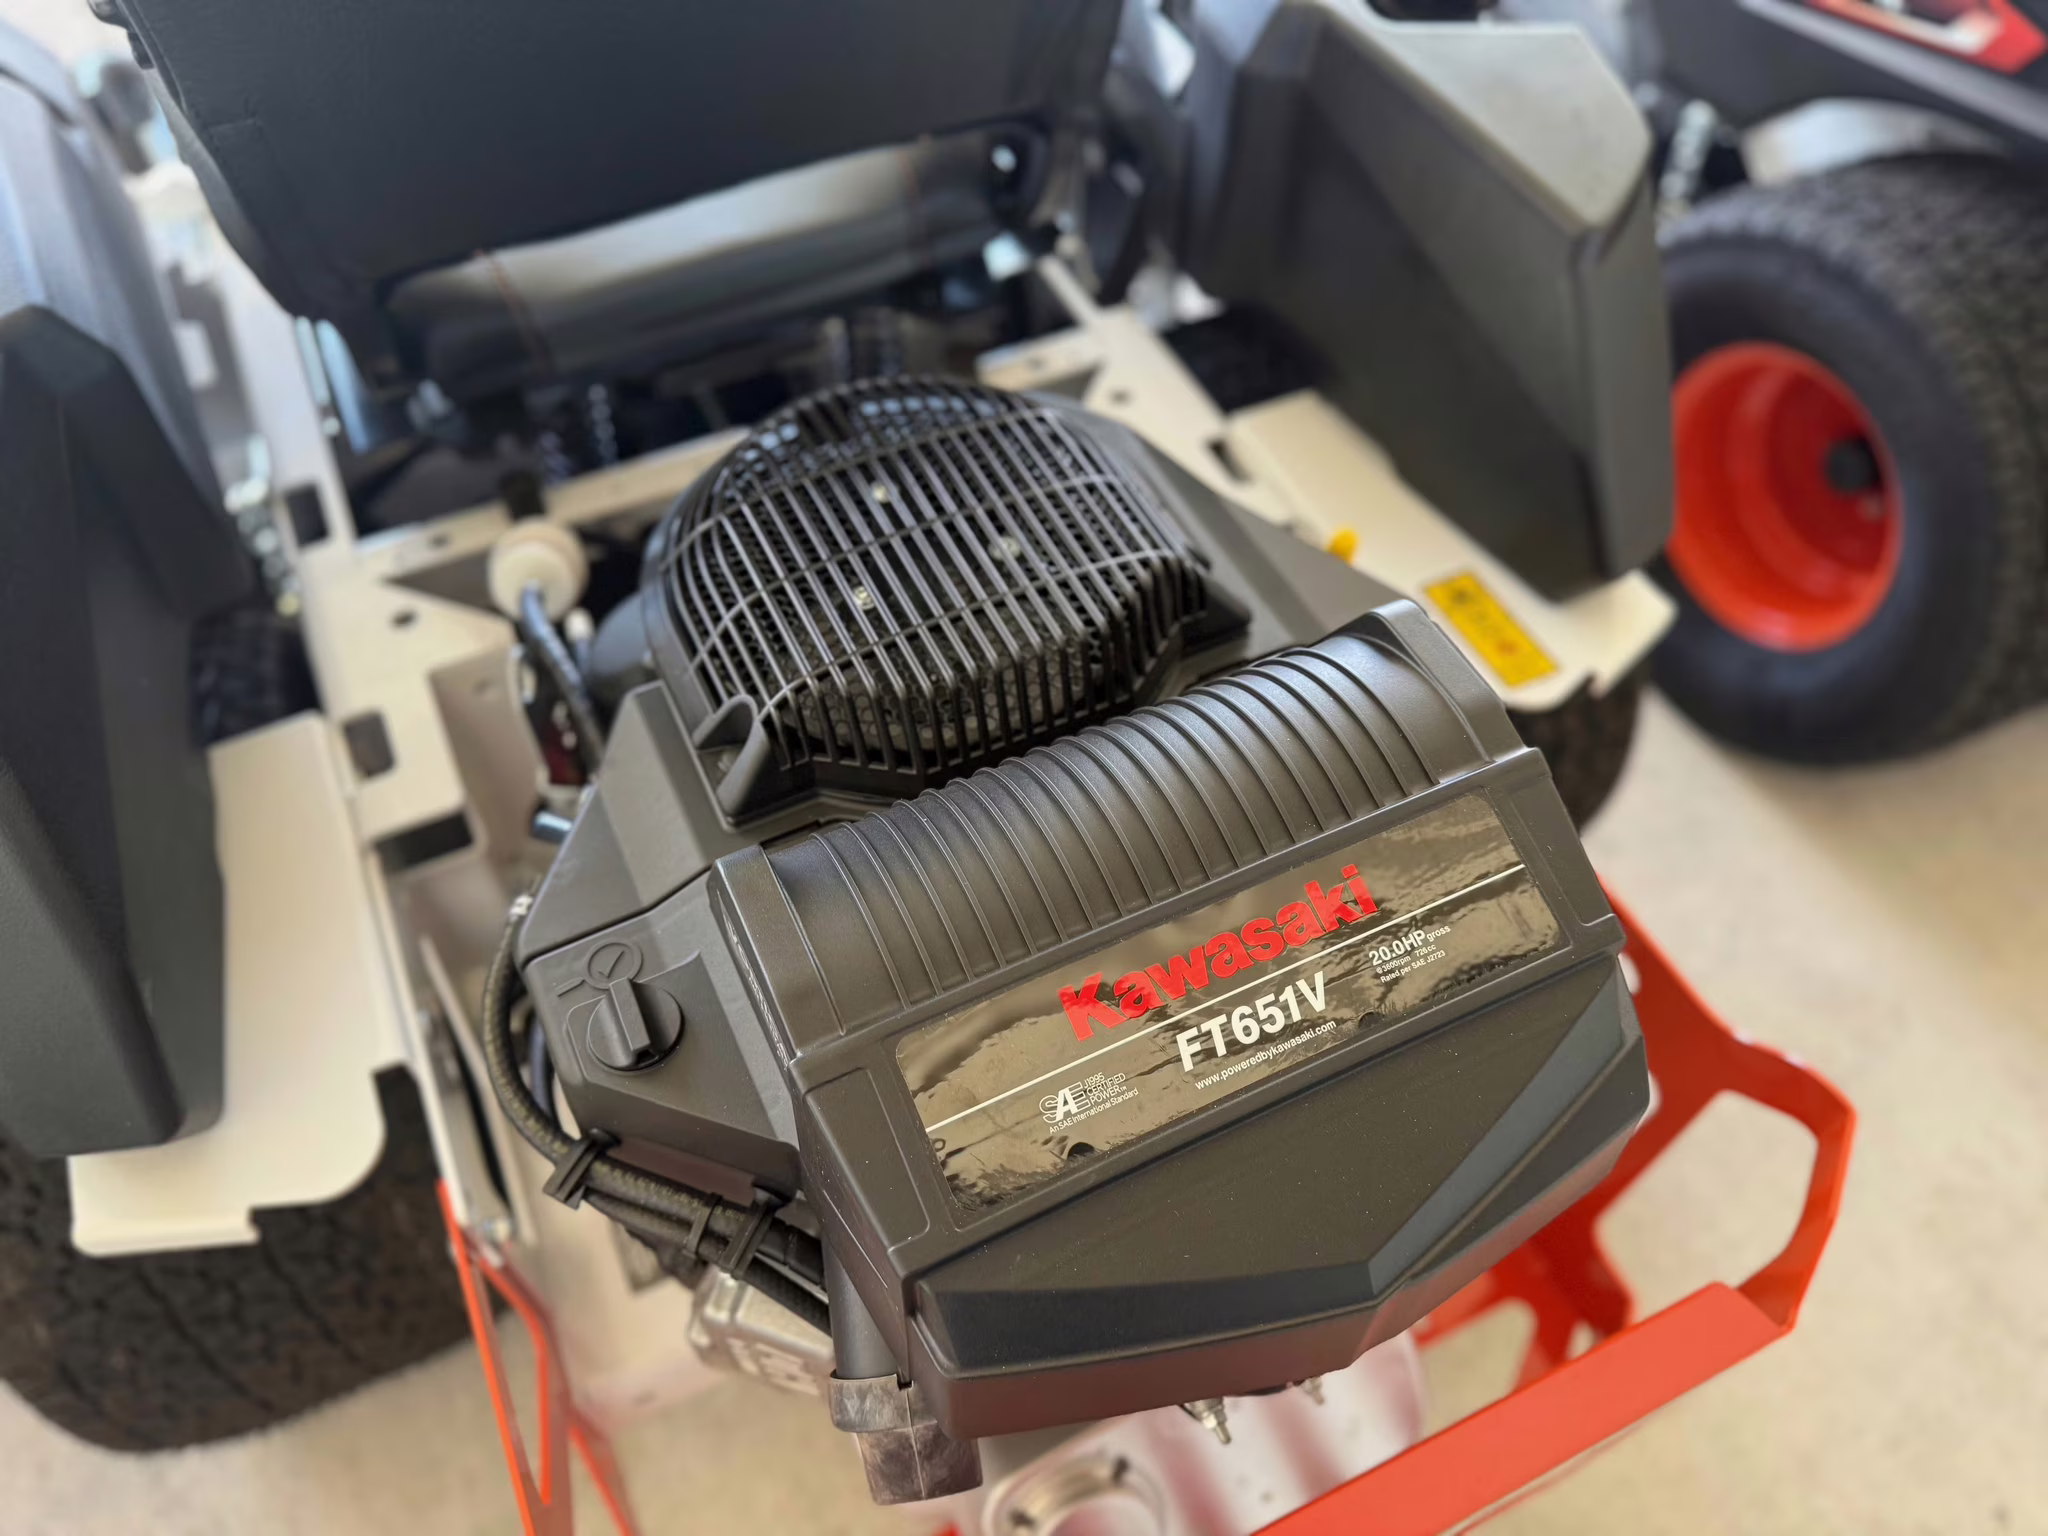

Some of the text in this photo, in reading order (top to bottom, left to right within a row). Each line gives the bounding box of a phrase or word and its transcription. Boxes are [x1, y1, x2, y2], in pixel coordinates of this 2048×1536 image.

[1058, 864, 1378, 1041] Kawasaki
[1369, 926, 1451, 966] 20.0HP gross
[1380, 950, 1446, 983] Rated per SAE J2723
[1176, 970, 1326, 1073] FT651V
[1195, 1020, 1337, 1090] www.poweredbykawasaki.com
[1084, 1072, 1105, 1088] J1995
[1087, 1073, 1126, 1096] CERTIFIED
[1039, 1082, 1091, 1123] SAE
[1049, 1087, 1139, 1134] An SAE International Standard
